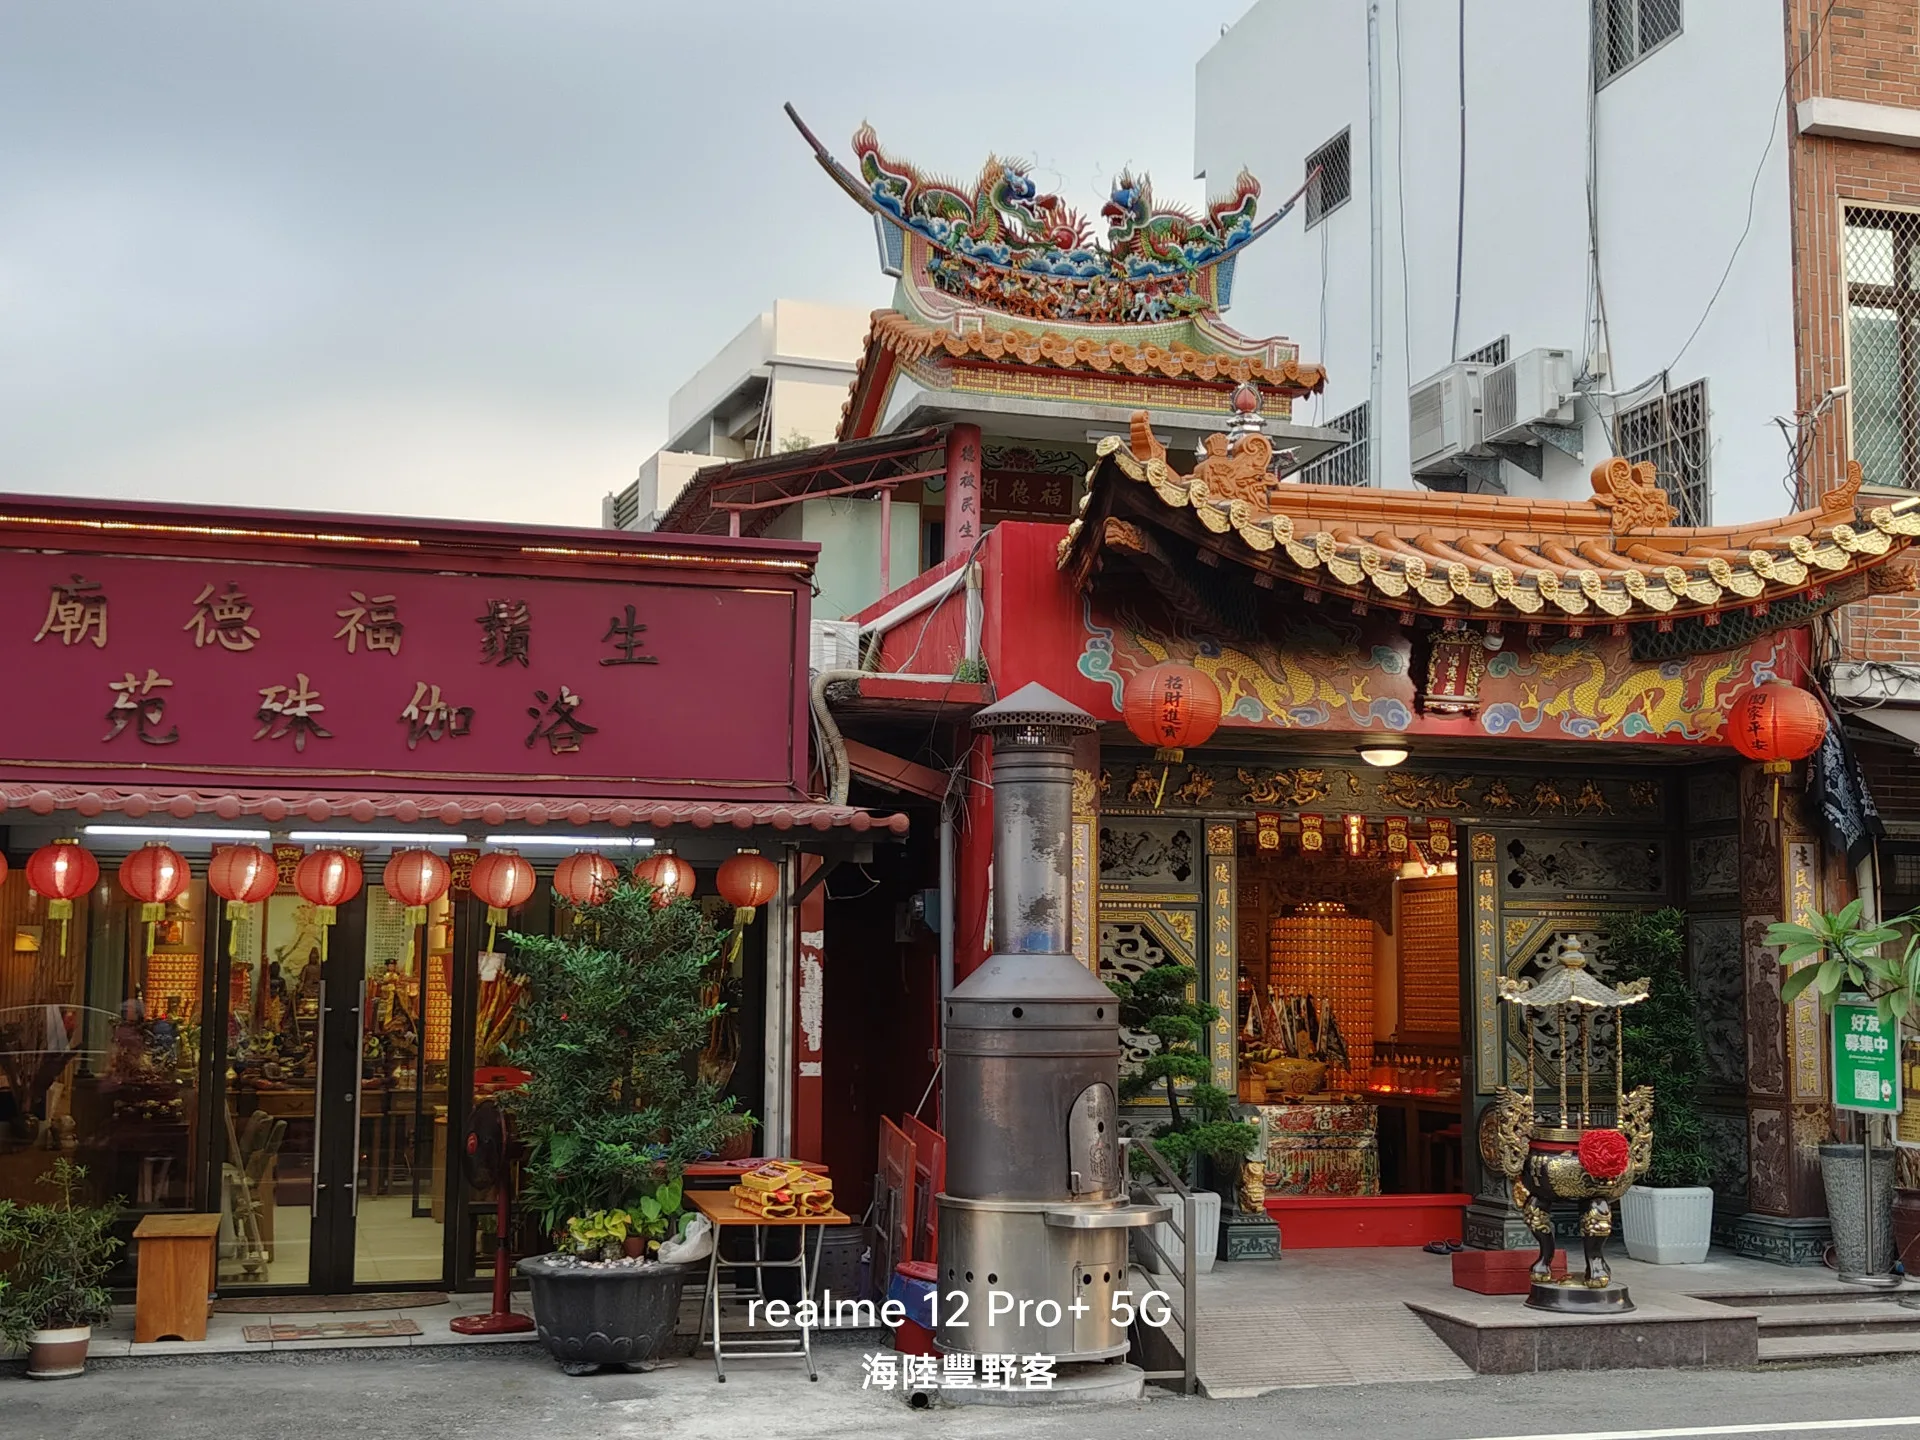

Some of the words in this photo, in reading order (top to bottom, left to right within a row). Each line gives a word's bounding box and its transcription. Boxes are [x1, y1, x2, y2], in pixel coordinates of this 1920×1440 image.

[1161, 674, 1183, 740] 招財進寶
[1851, 1013, 1881, 1033] 好友
[1845, 1033, 1888, 1054] 募集中
